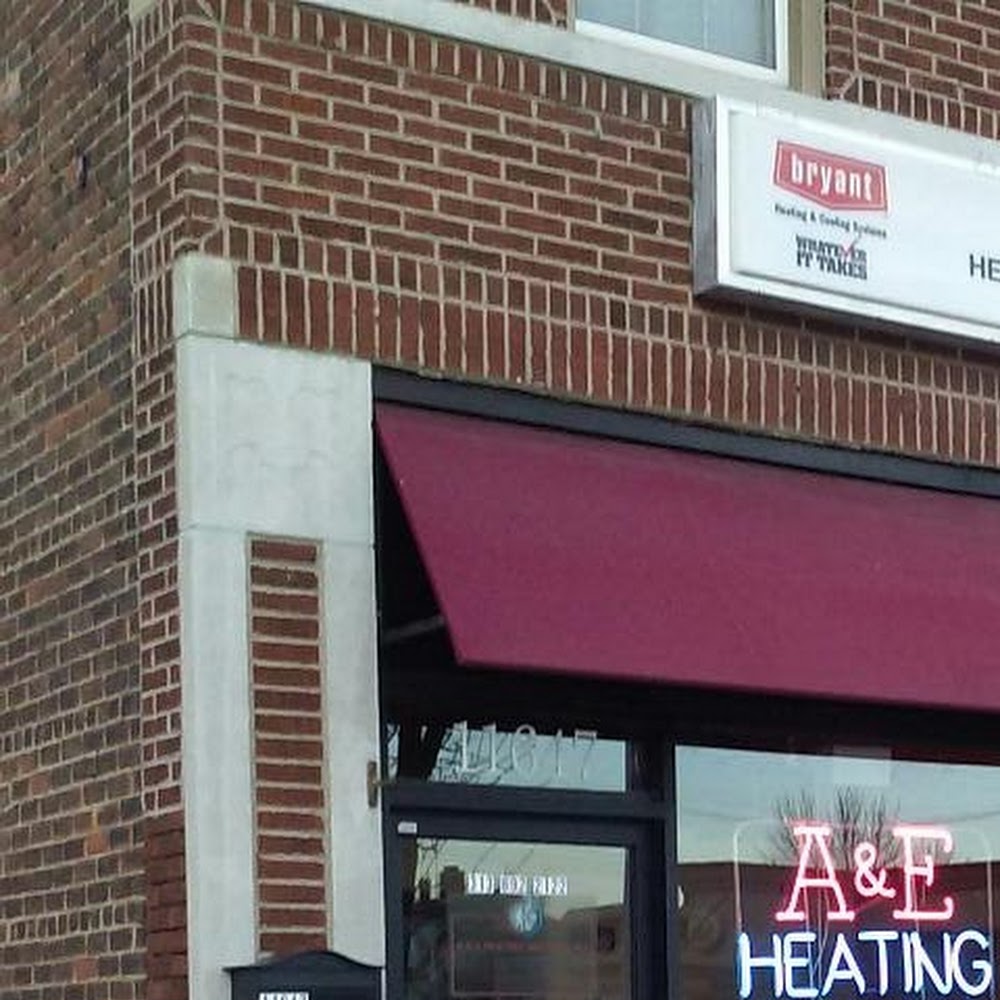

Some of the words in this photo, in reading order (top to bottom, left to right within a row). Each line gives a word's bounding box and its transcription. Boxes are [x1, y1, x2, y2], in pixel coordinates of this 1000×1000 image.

[791, 153, 872, 201] bryant
[816, 254, 867, 280] TAKES
[739, 930, 992, 998] HEATING
